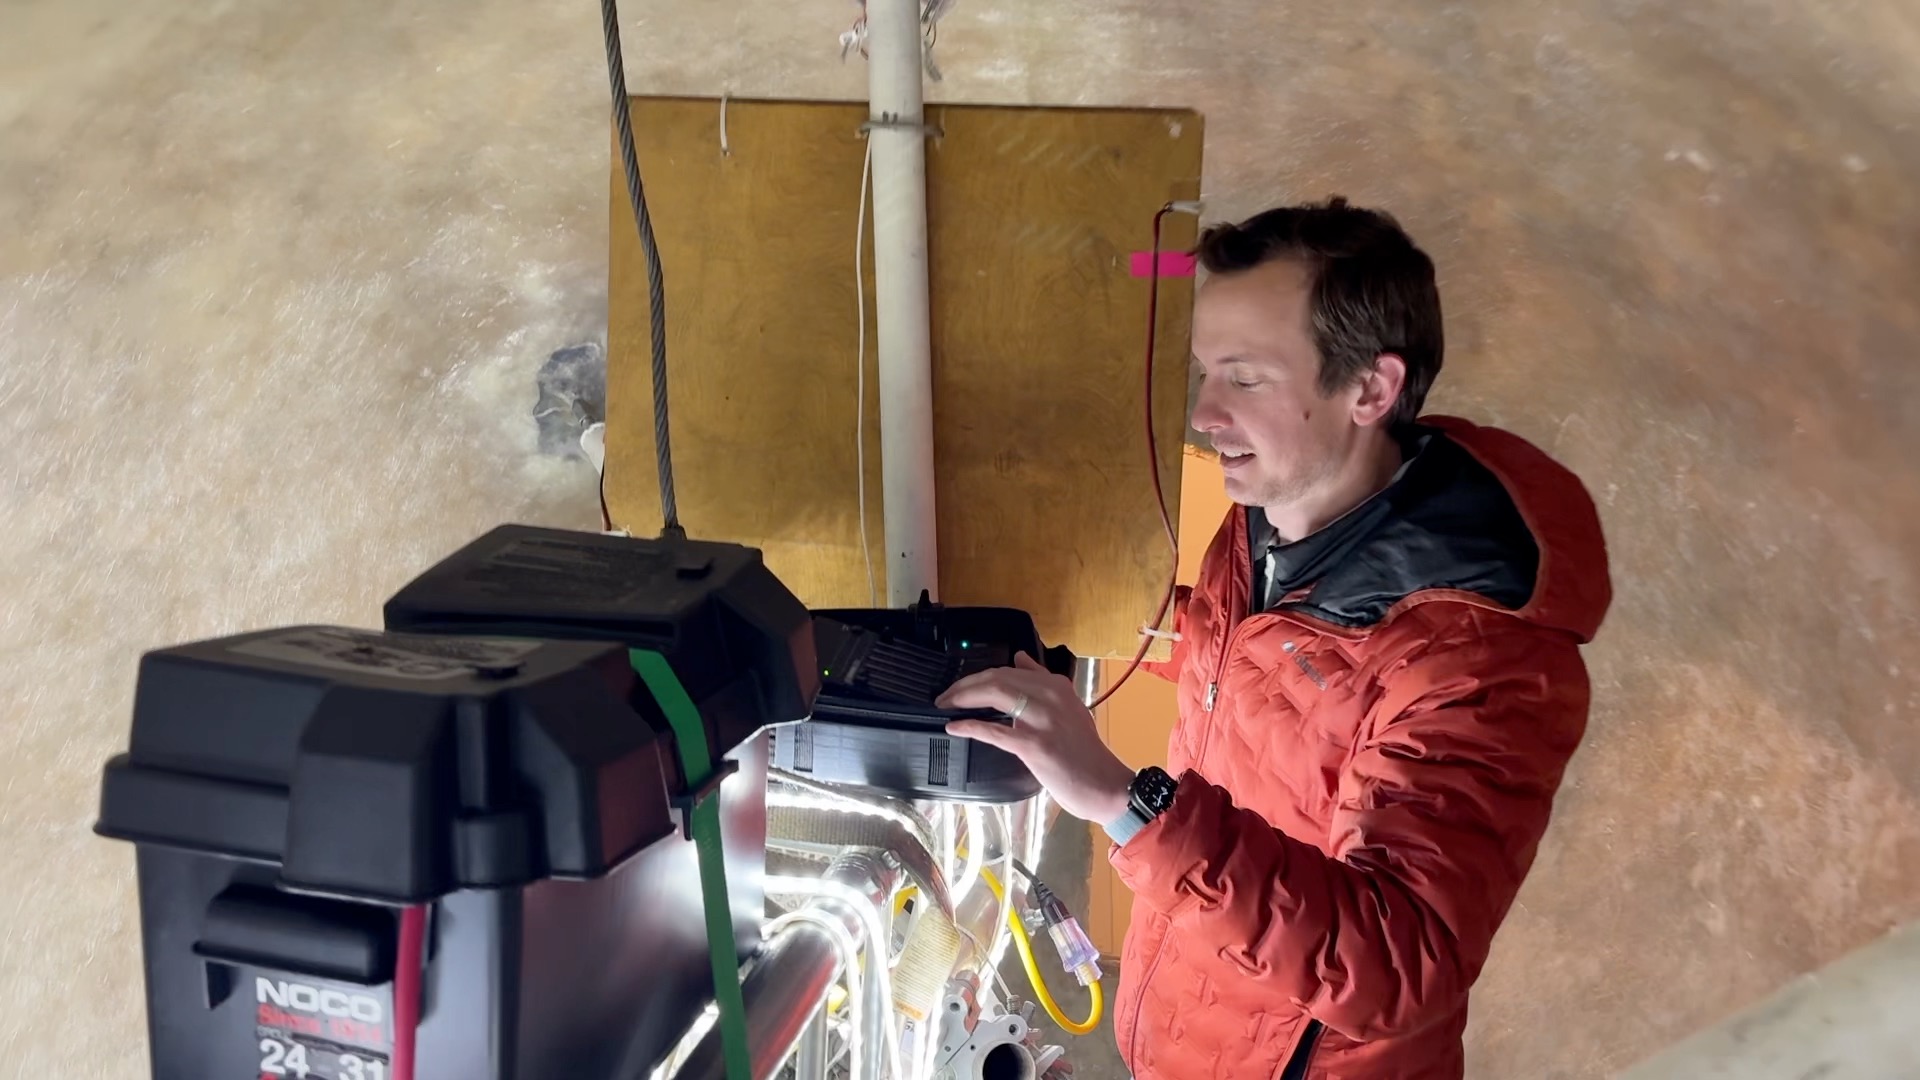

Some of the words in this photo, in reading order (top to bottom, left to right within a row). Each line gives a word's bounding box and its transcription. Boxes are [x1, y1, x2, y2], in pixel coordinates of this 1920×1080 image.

[255, 977, 382, 1024] NOCO
[260, 1038, 309, 1079] 24
[338, 1054, 384, 1080] 31
